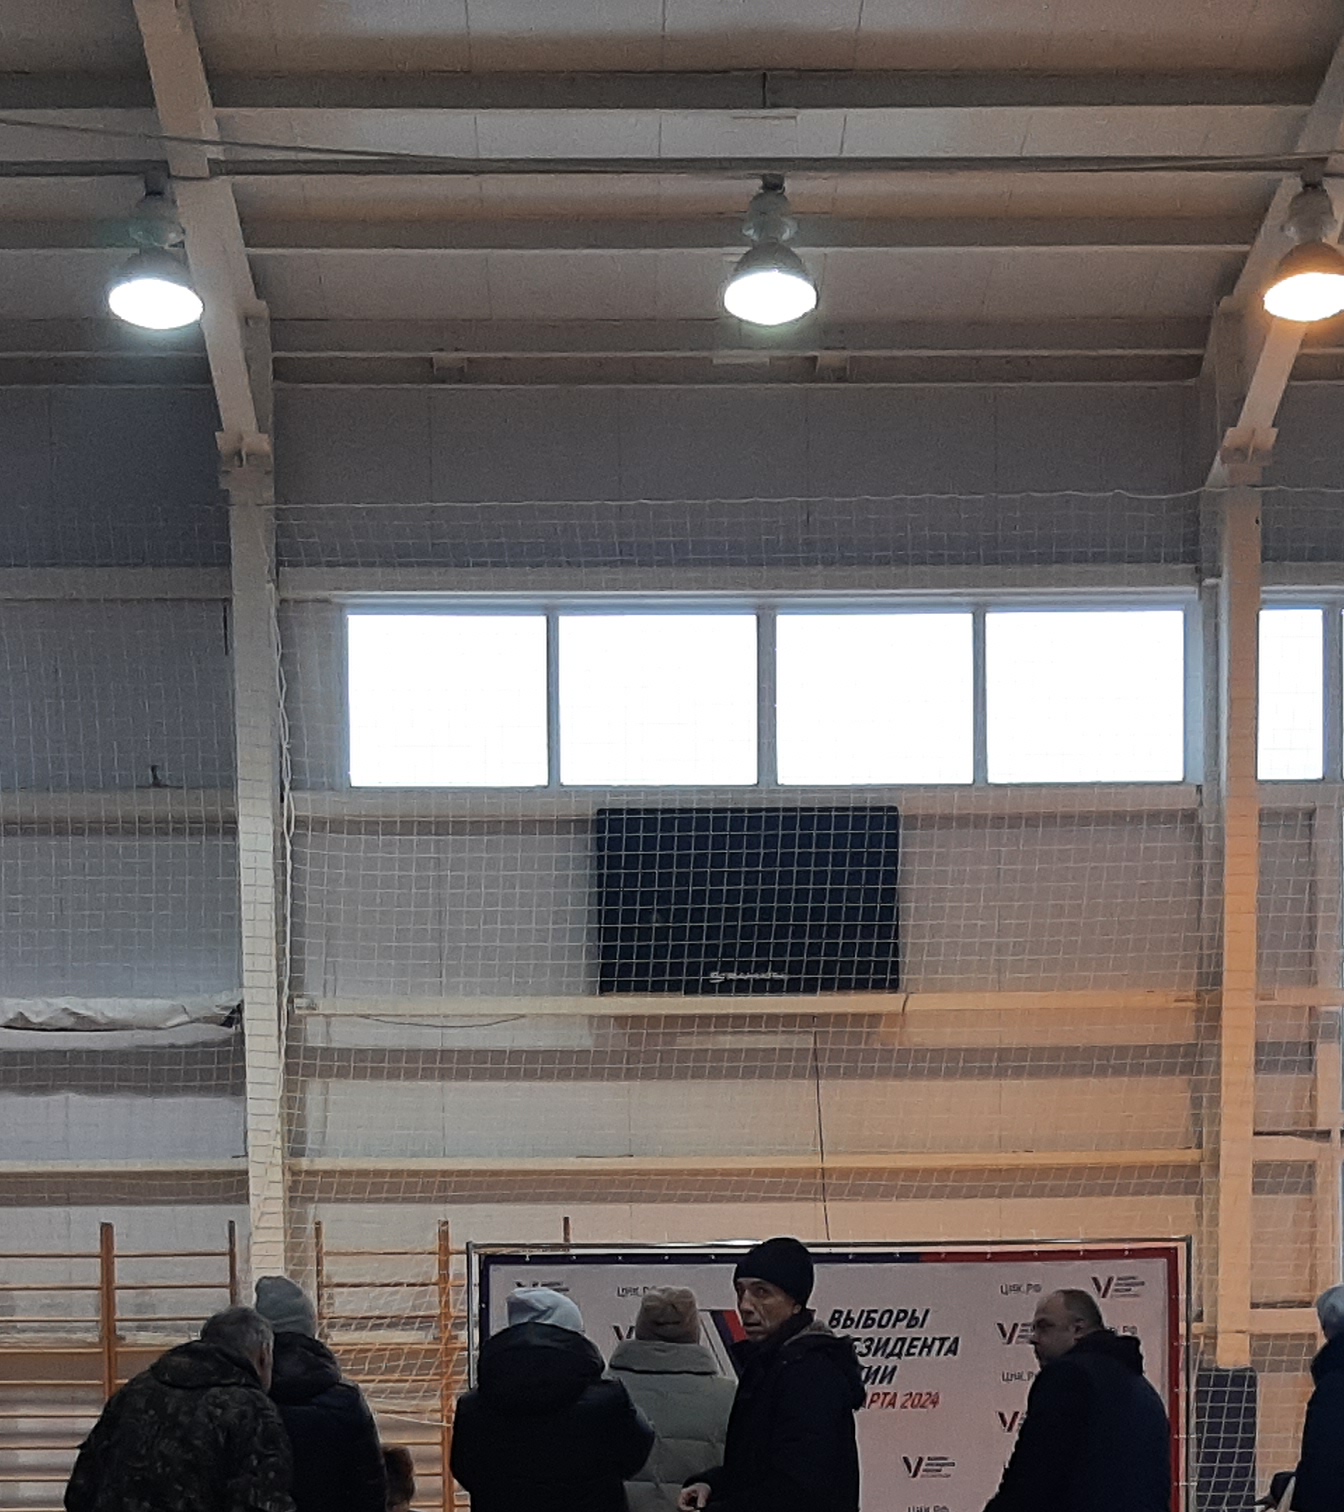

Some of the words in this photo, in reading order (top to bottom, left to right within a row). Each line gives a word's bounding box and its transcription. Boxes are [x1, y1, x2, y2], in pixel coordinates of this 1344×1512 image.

[828, 1308, 931, 1329] ВЫБОРЫ
[853, 1336, 961, 1360] ЗИДЕНТА
[862, 1391, 898, 1410] РТА
[900, 1391, 941, 1409] 2024
